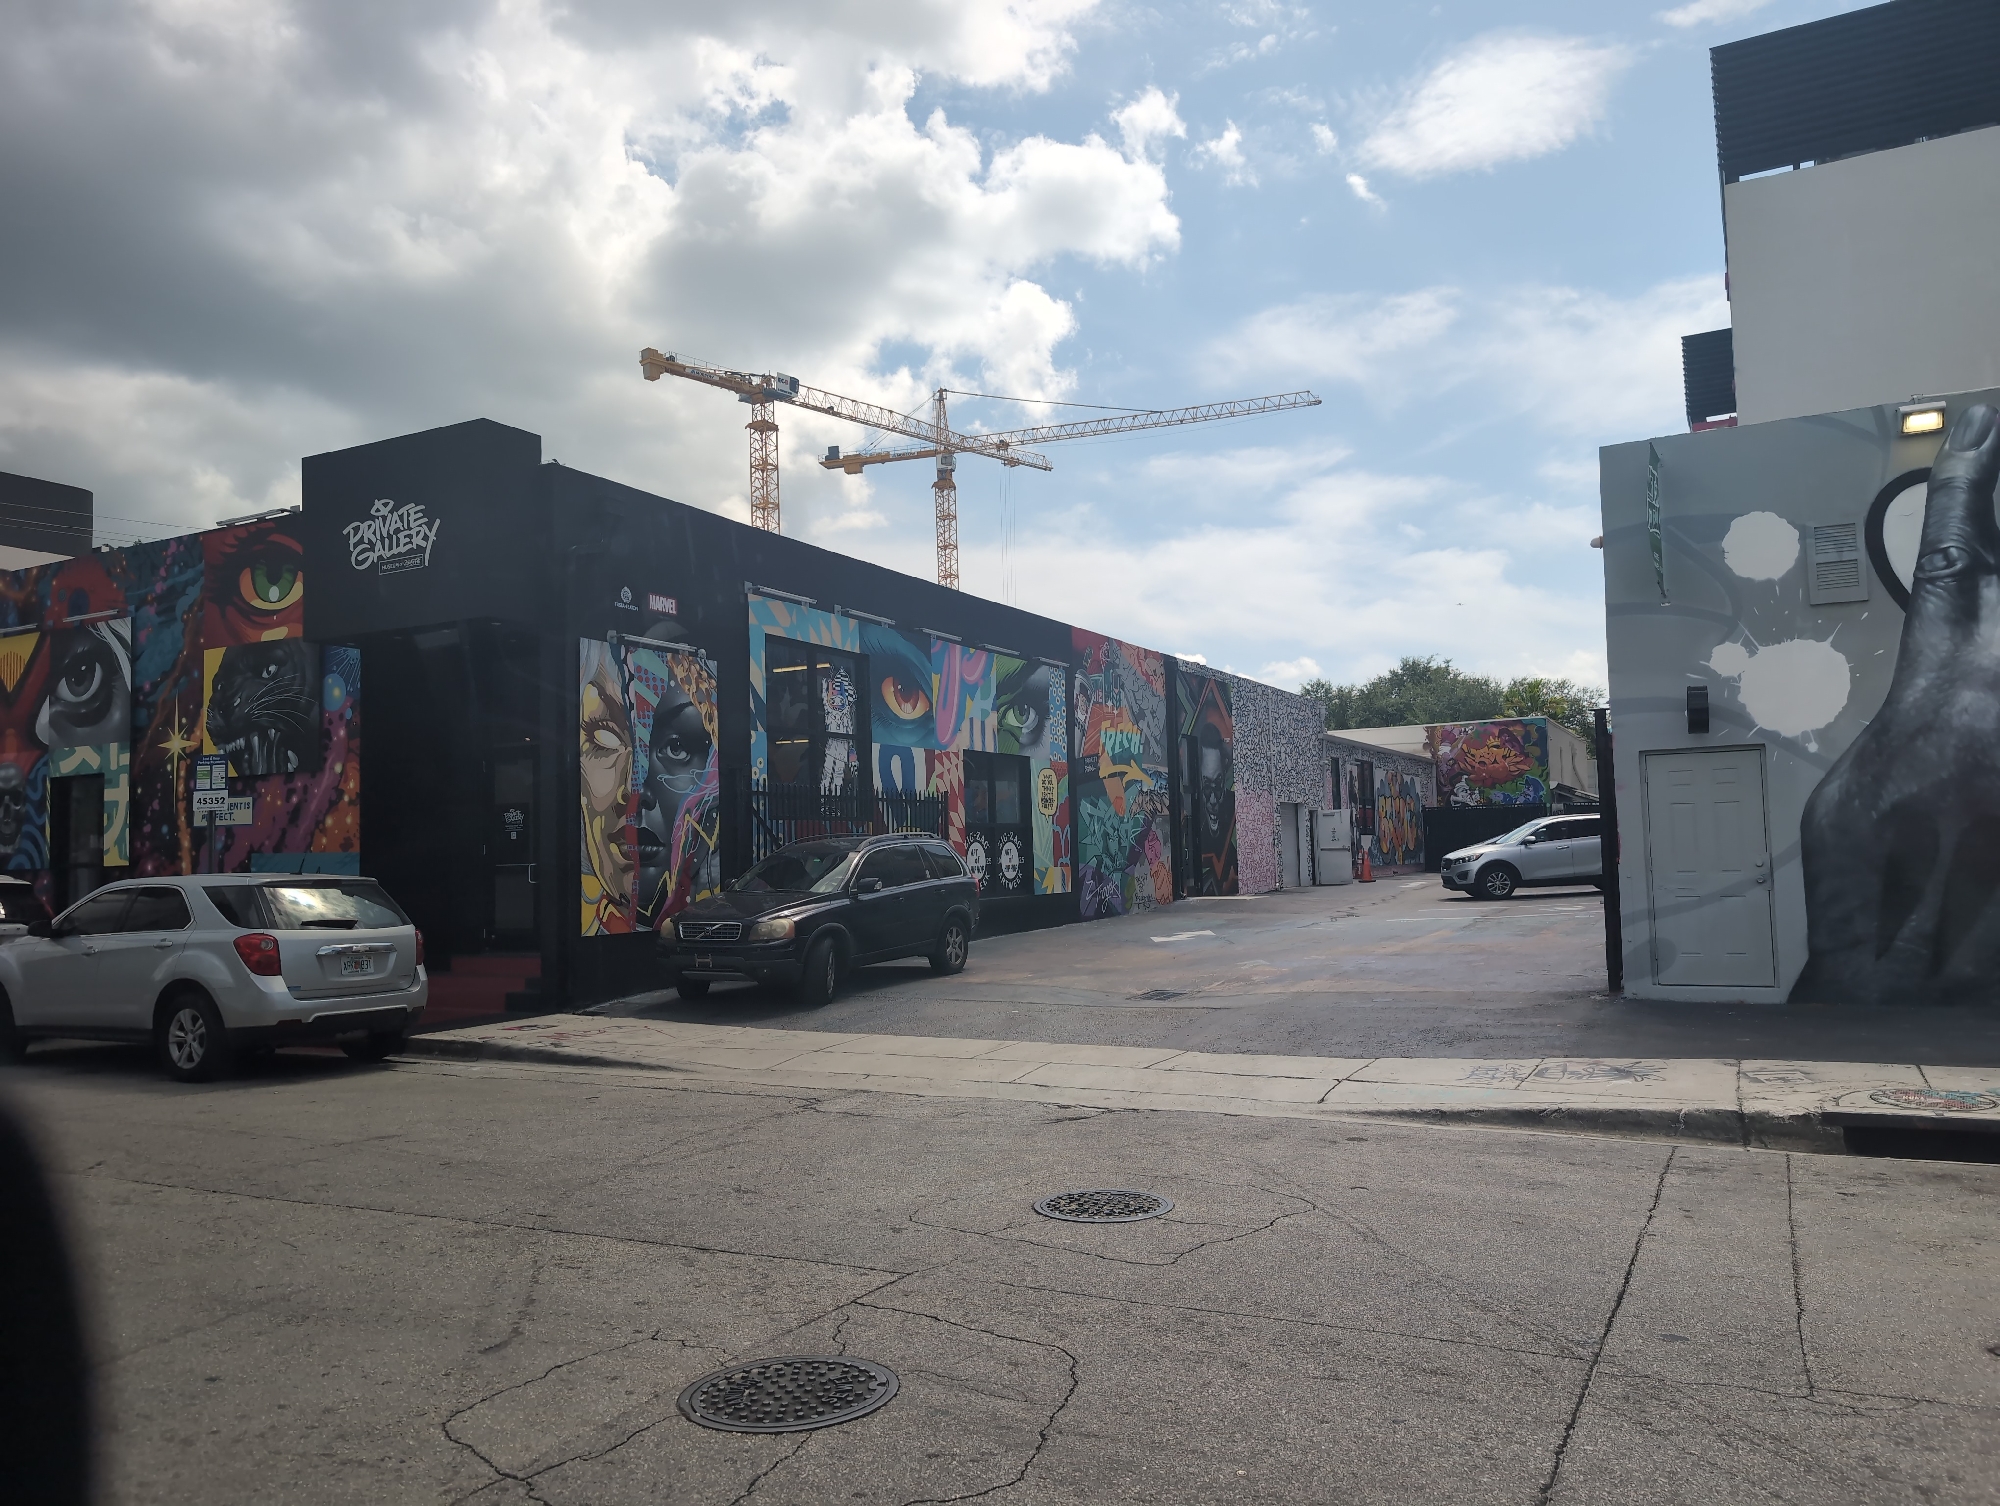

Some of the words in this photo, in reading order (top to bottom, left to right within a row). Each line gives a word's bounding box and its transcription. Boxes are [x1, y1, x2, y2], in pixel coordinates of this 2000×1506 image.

[343, 503, 428, 551] PRIVATE
[351, 519, 440, 570] GALLERY
[649, 594, 677, 615] MARVEL
[196, 796, 226, 805] 45352
[244, 801, 251, 810] IS
